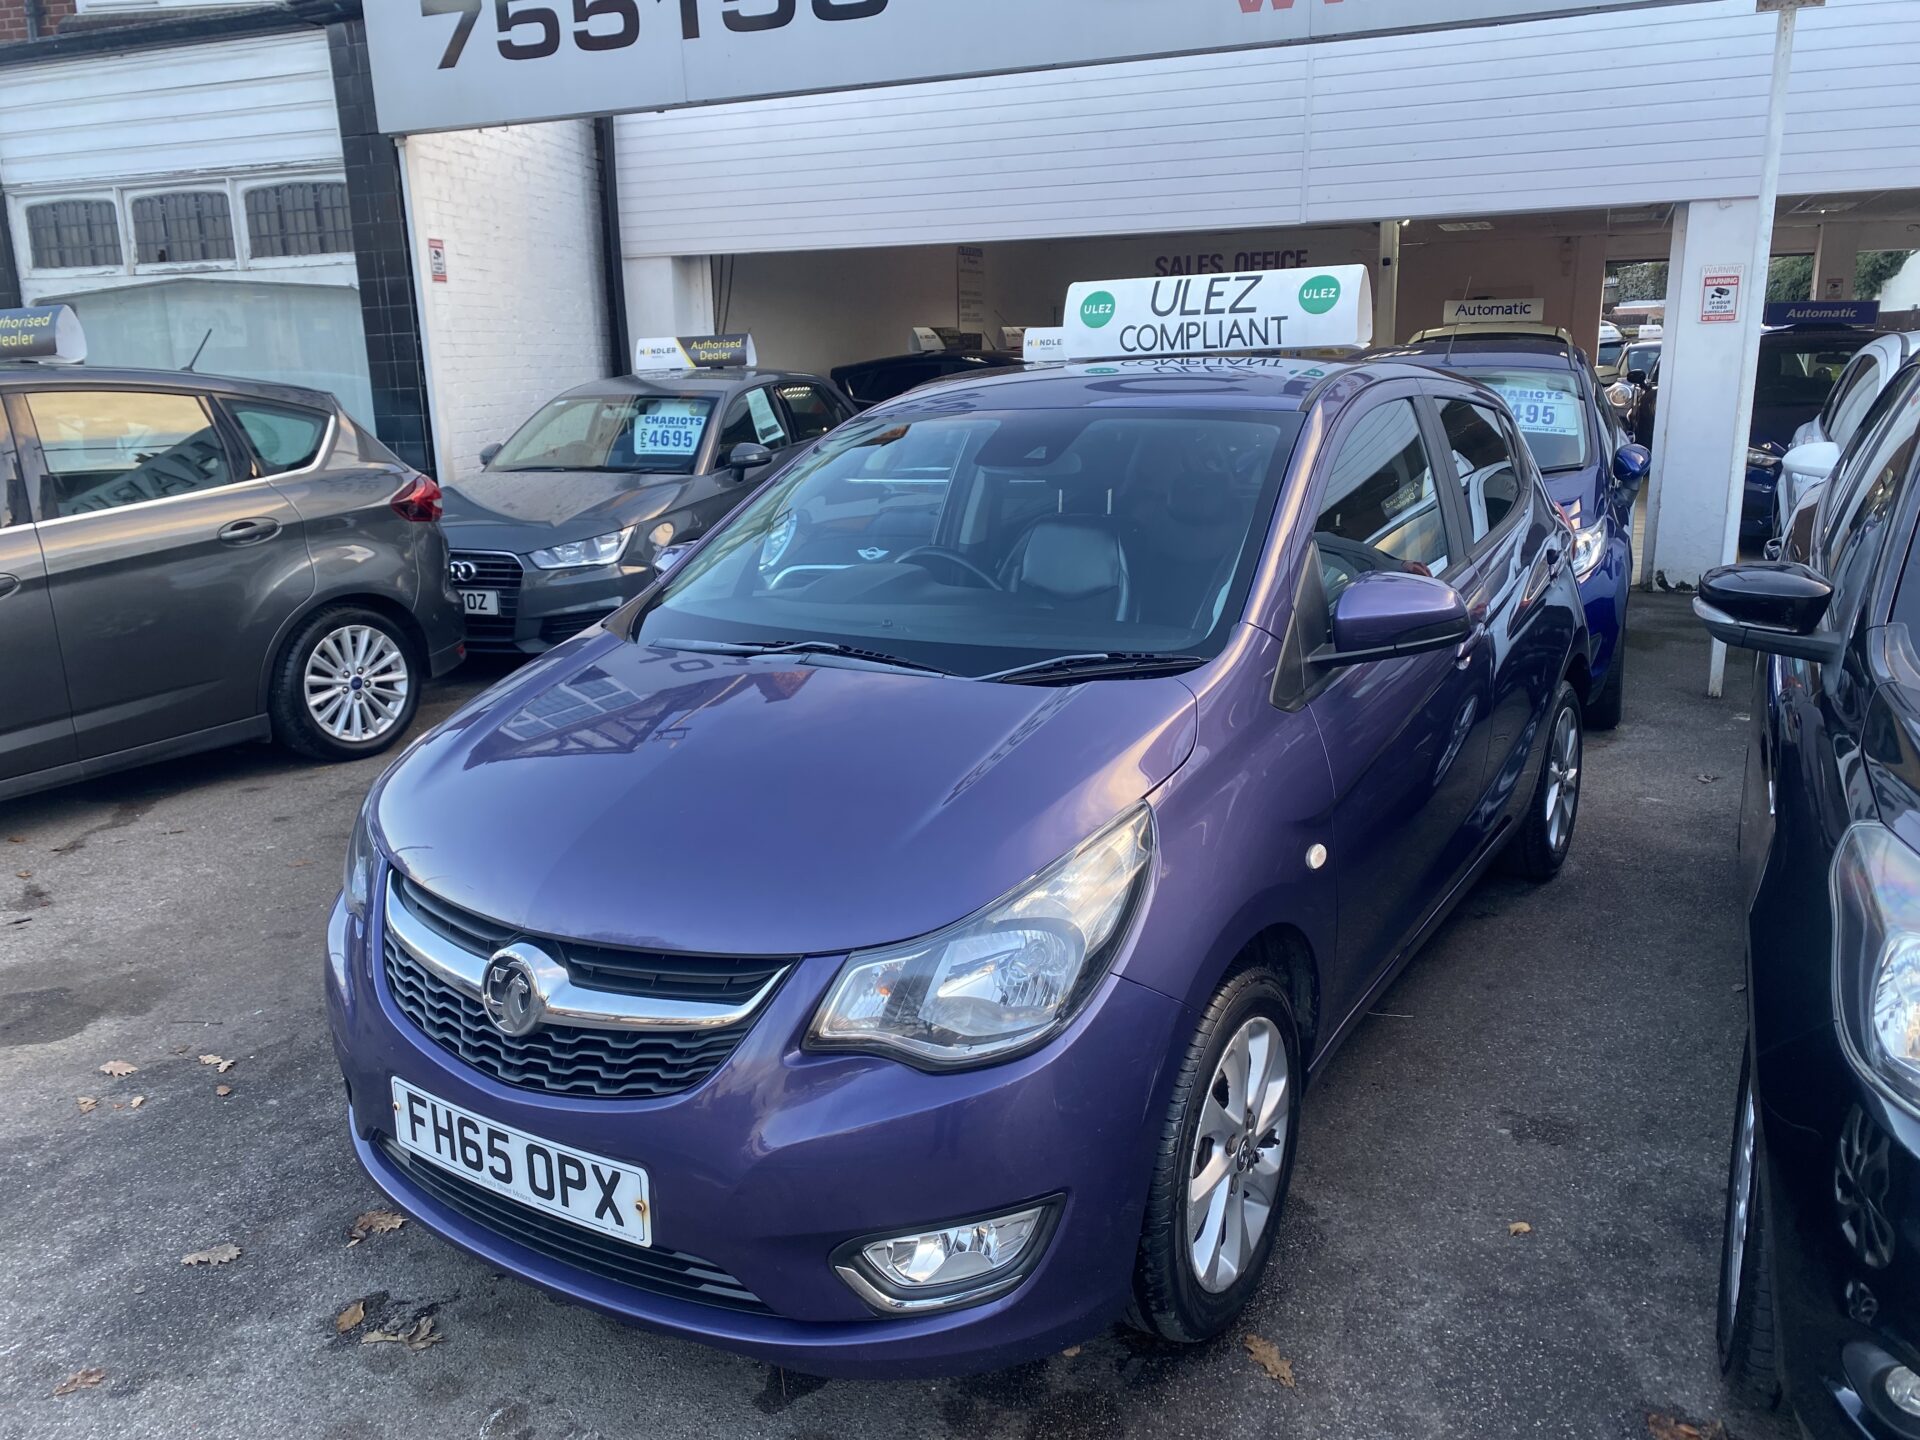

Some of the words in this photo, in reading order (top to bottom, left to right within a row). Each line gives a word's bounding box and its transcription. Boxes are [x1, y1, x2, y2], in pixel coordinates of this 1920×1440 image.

[1154, 253, 1224, 276] SALES
[1234, 249, 1308, 271] OFFICE
[1151, 275, 1263, 316] ULEZ
[1303, 286, 1337, 300] ULEZ
[1084, 303, 1112, 314] ULEZ
[1455, 302, 1532, 316] Automatic
[1786, 307, 1857, 318] Automatic
[0, 330, 34, 347] ealer
[1119, 316, 1288, 352] COMPLIANT
[690, 339, 742, 350] Authorised
[699, 351, 732, 360] Dealer
[1497, 389, 1563, 400] HARIOTS
[645, 416, 703, 426] CHARIOTS
[649, 429, 693, 448] 4695
[462, 593, 487, 610] OZ
[406, 1091, 513, 1185] FH65
[525, 1142, 625, 1228] OPX
